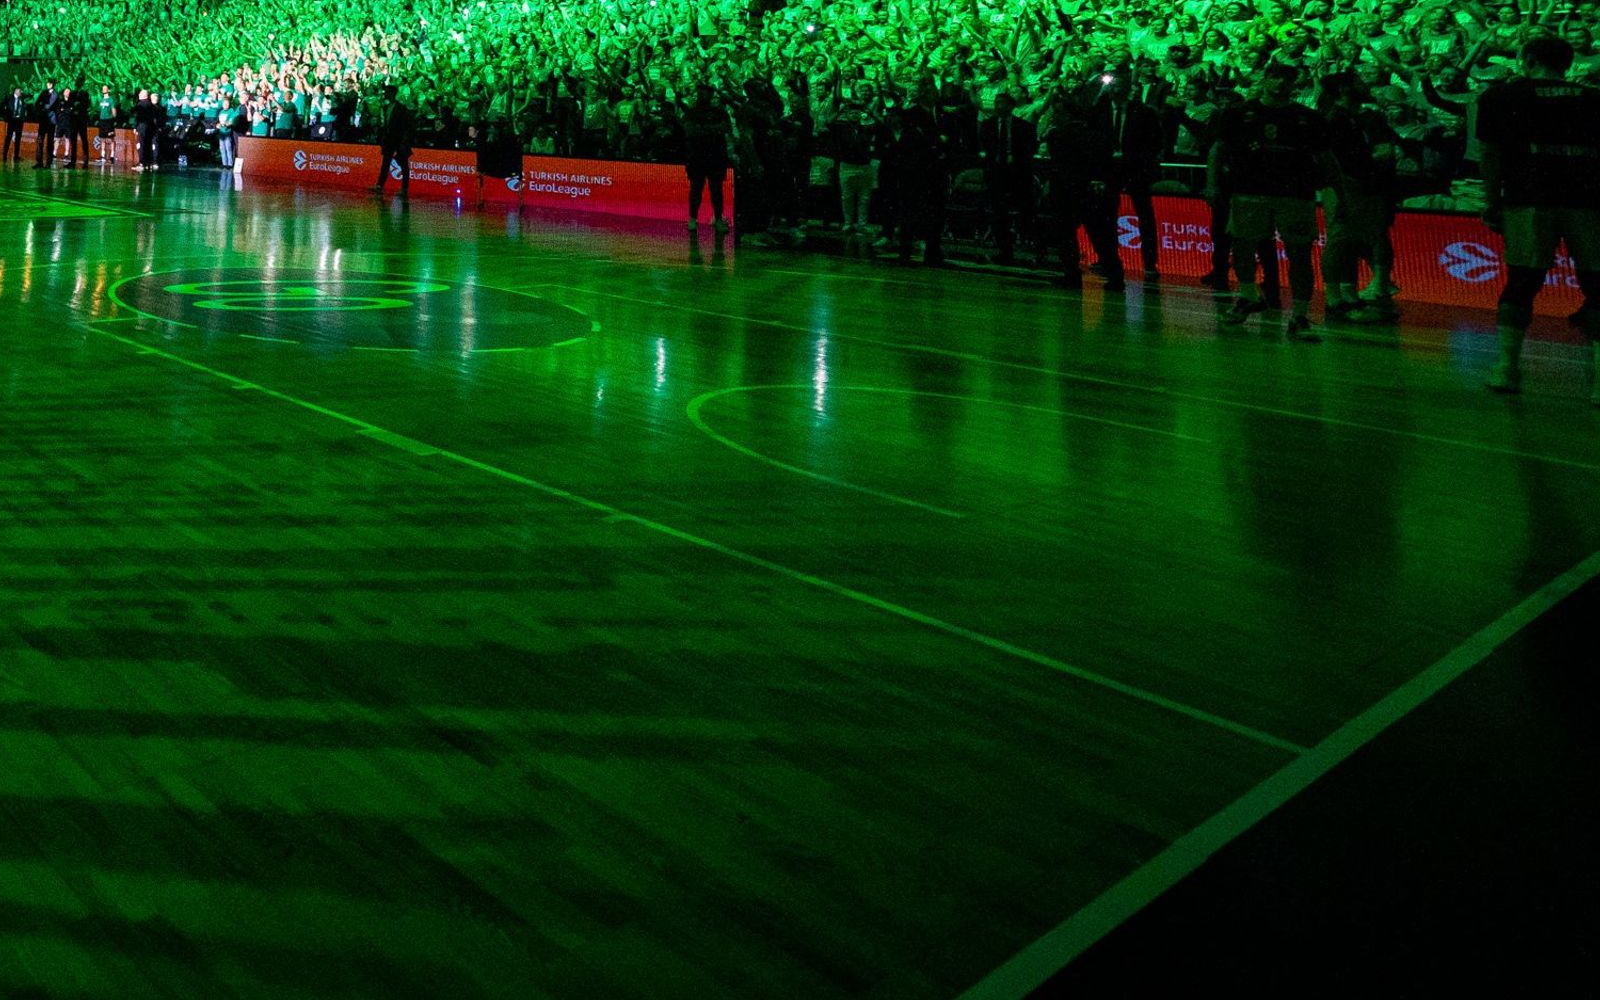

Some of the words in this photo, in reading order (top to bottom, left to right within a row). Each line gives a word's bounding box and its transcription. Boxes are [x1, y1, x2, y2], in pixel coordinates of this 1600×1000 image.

[309, 153, 335, 163] TURKISH
[336, 155, 365, 166] AIRLINES
[309, 162, 350, 176] EuroLeague
[409, 161, 441, 172] TURKISH
[442, 163, 477, 175] AIRLINES
[409, 171, 459, 186] EuroLeague
[529, 171, 568, 183] TURKISH
[570, 174, 613, 186] AIRLINES
[528, 181, 591, 198] EuroLeague
[1162, 222, 1211, 237] TURK
